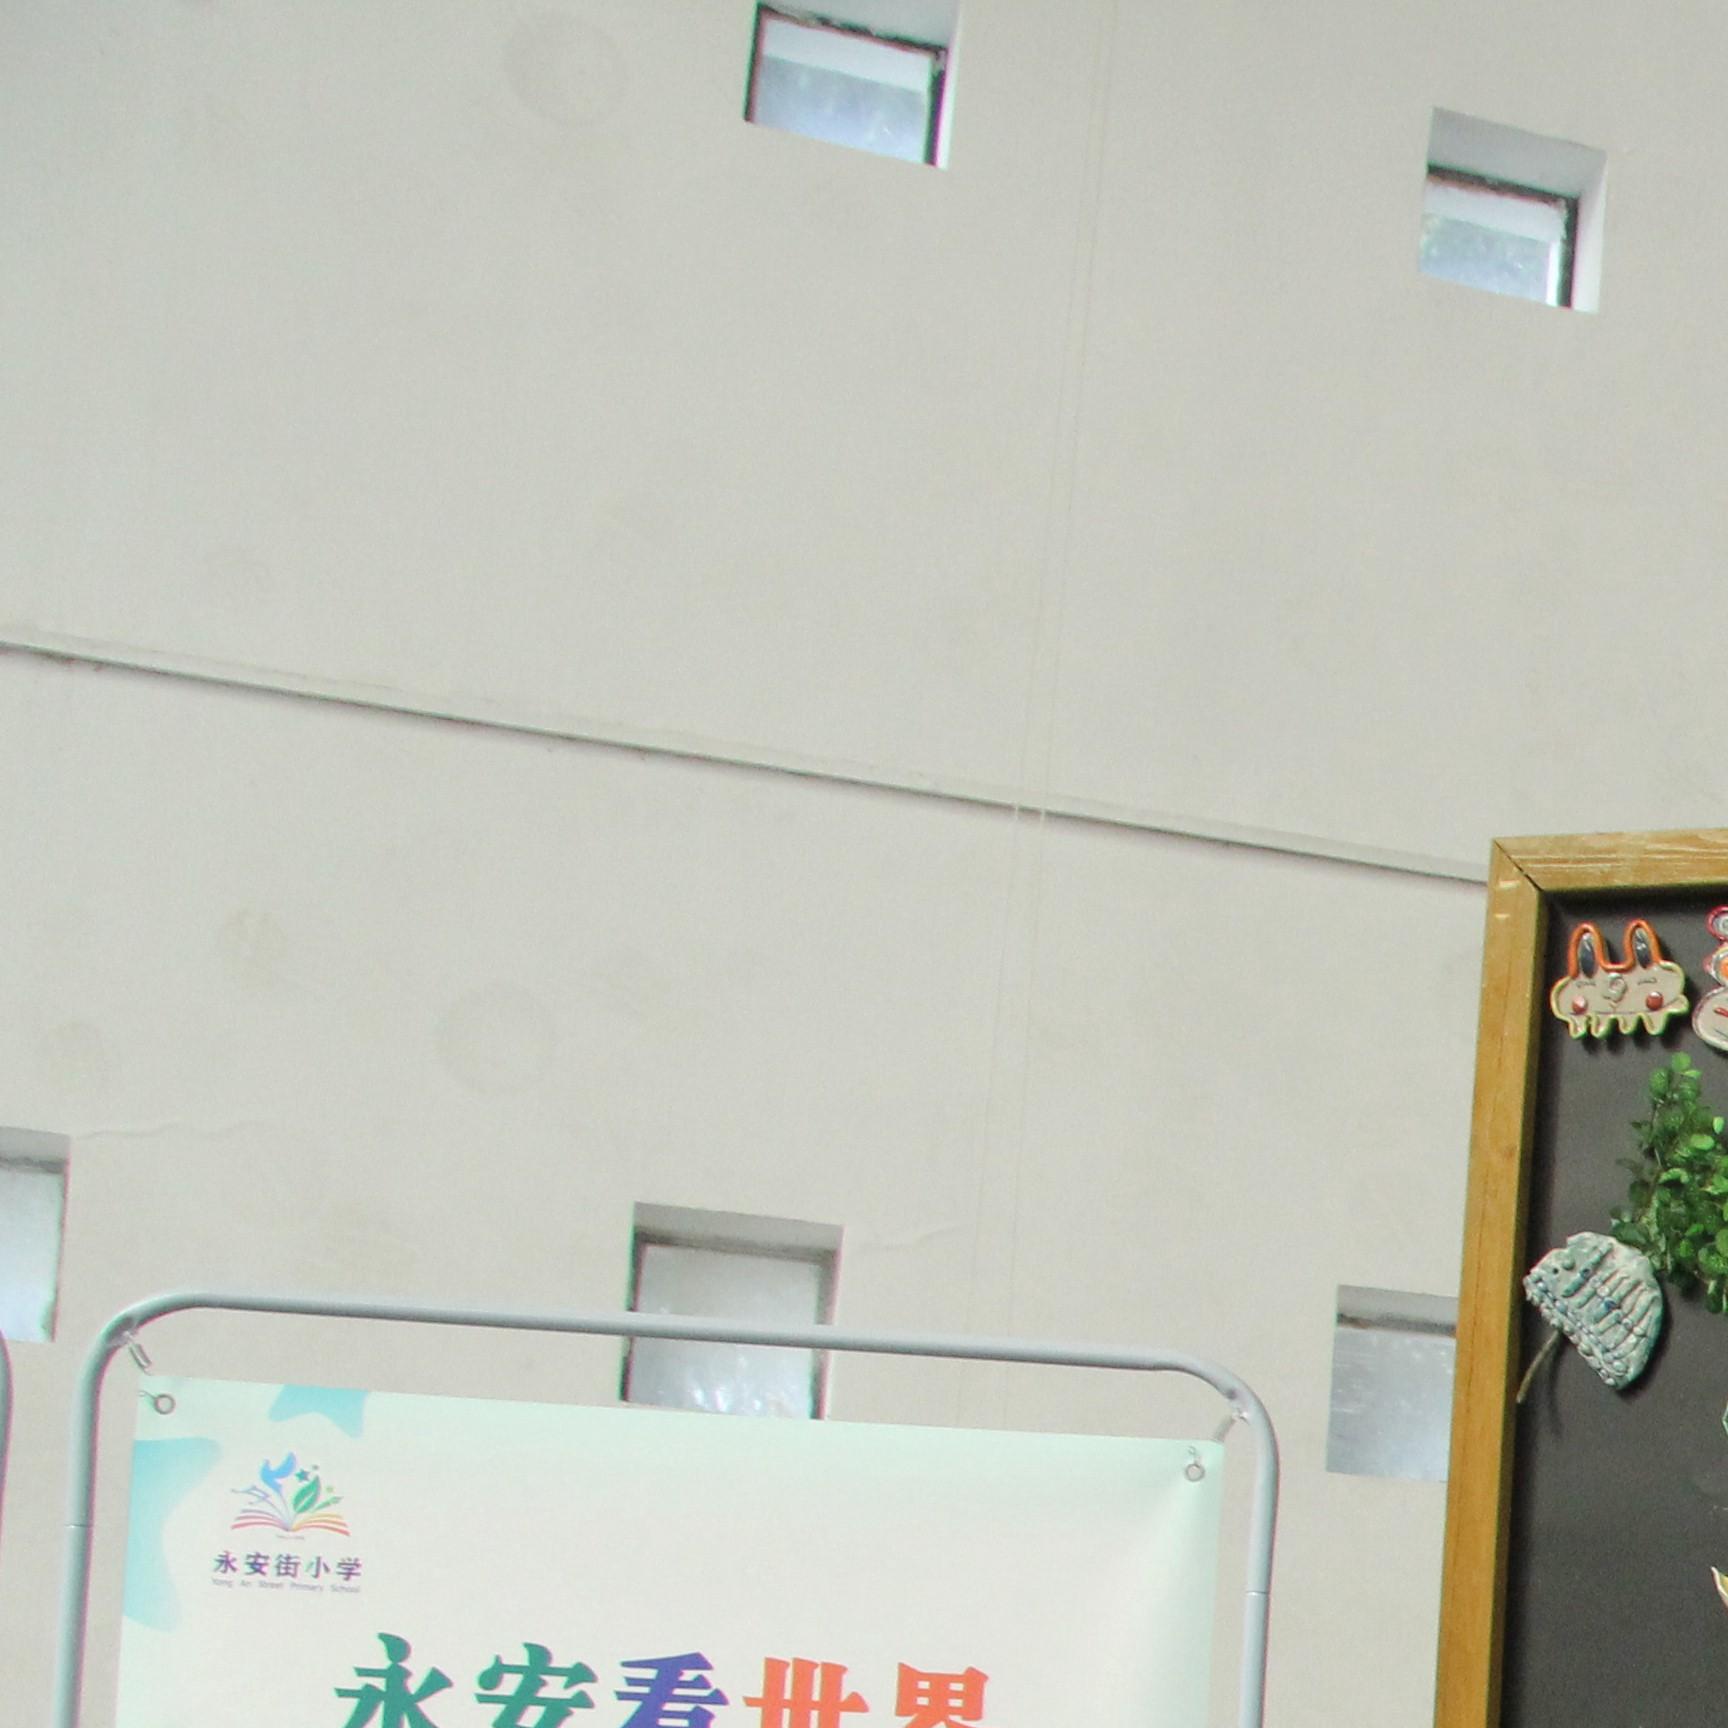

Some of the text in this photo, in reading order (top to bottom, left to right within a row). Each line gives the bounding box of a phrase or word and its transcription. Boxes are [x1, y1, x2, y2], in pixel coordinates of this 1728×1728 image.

[214, 1551, 362, 1581] 永安街小学
[331, 1583, 361, 1594] School
